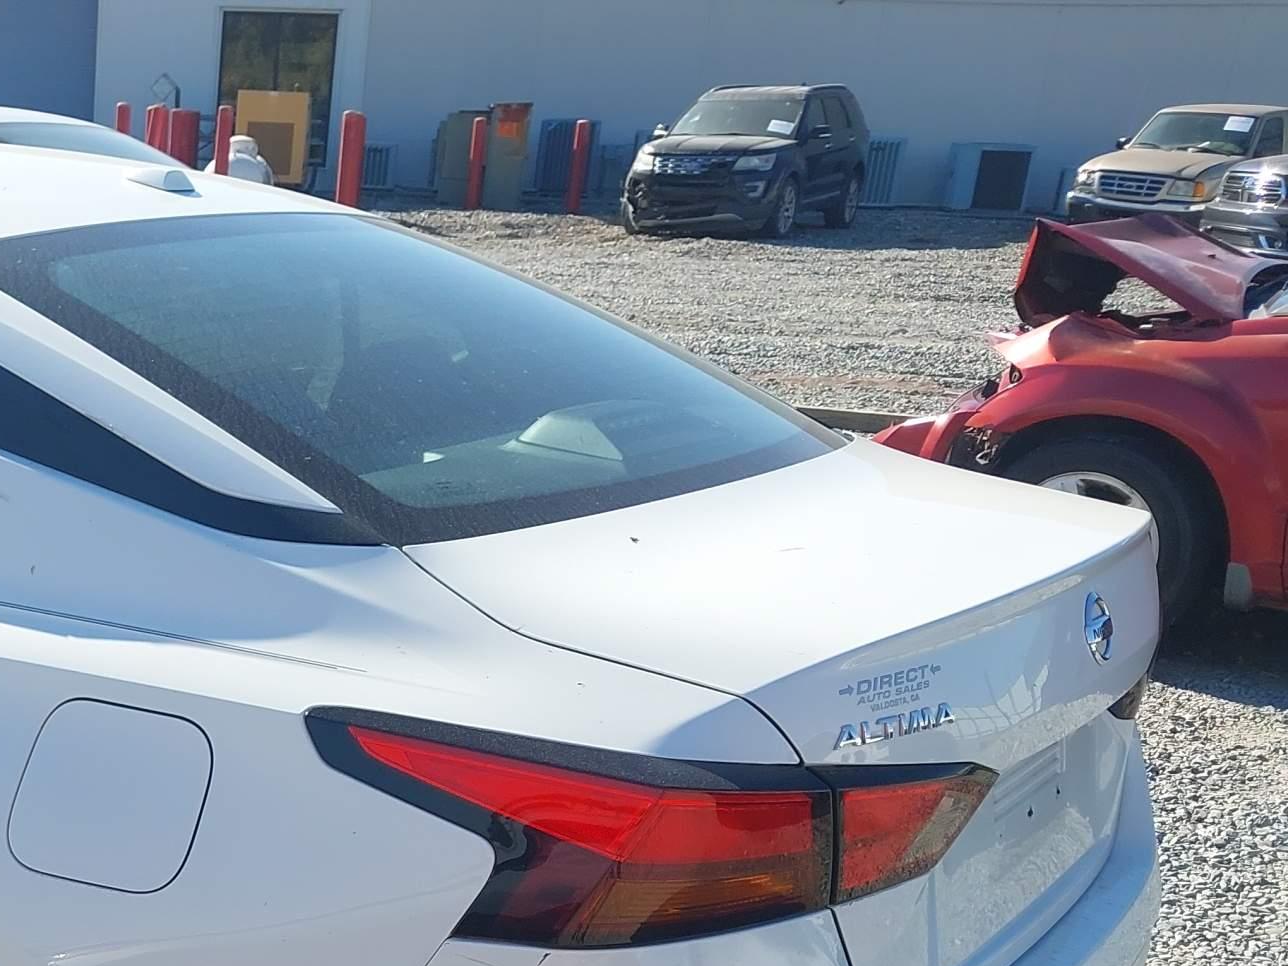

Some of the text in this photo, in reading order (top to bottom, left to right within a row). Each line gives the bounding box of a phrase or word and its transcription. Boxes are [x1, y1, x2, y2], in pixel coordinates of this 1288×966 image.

[856, 664, 929, 695] DIRECT
[857, 680, 930, 705] AUTO SALES
[832, 702, 955, 750] ALTIMA
